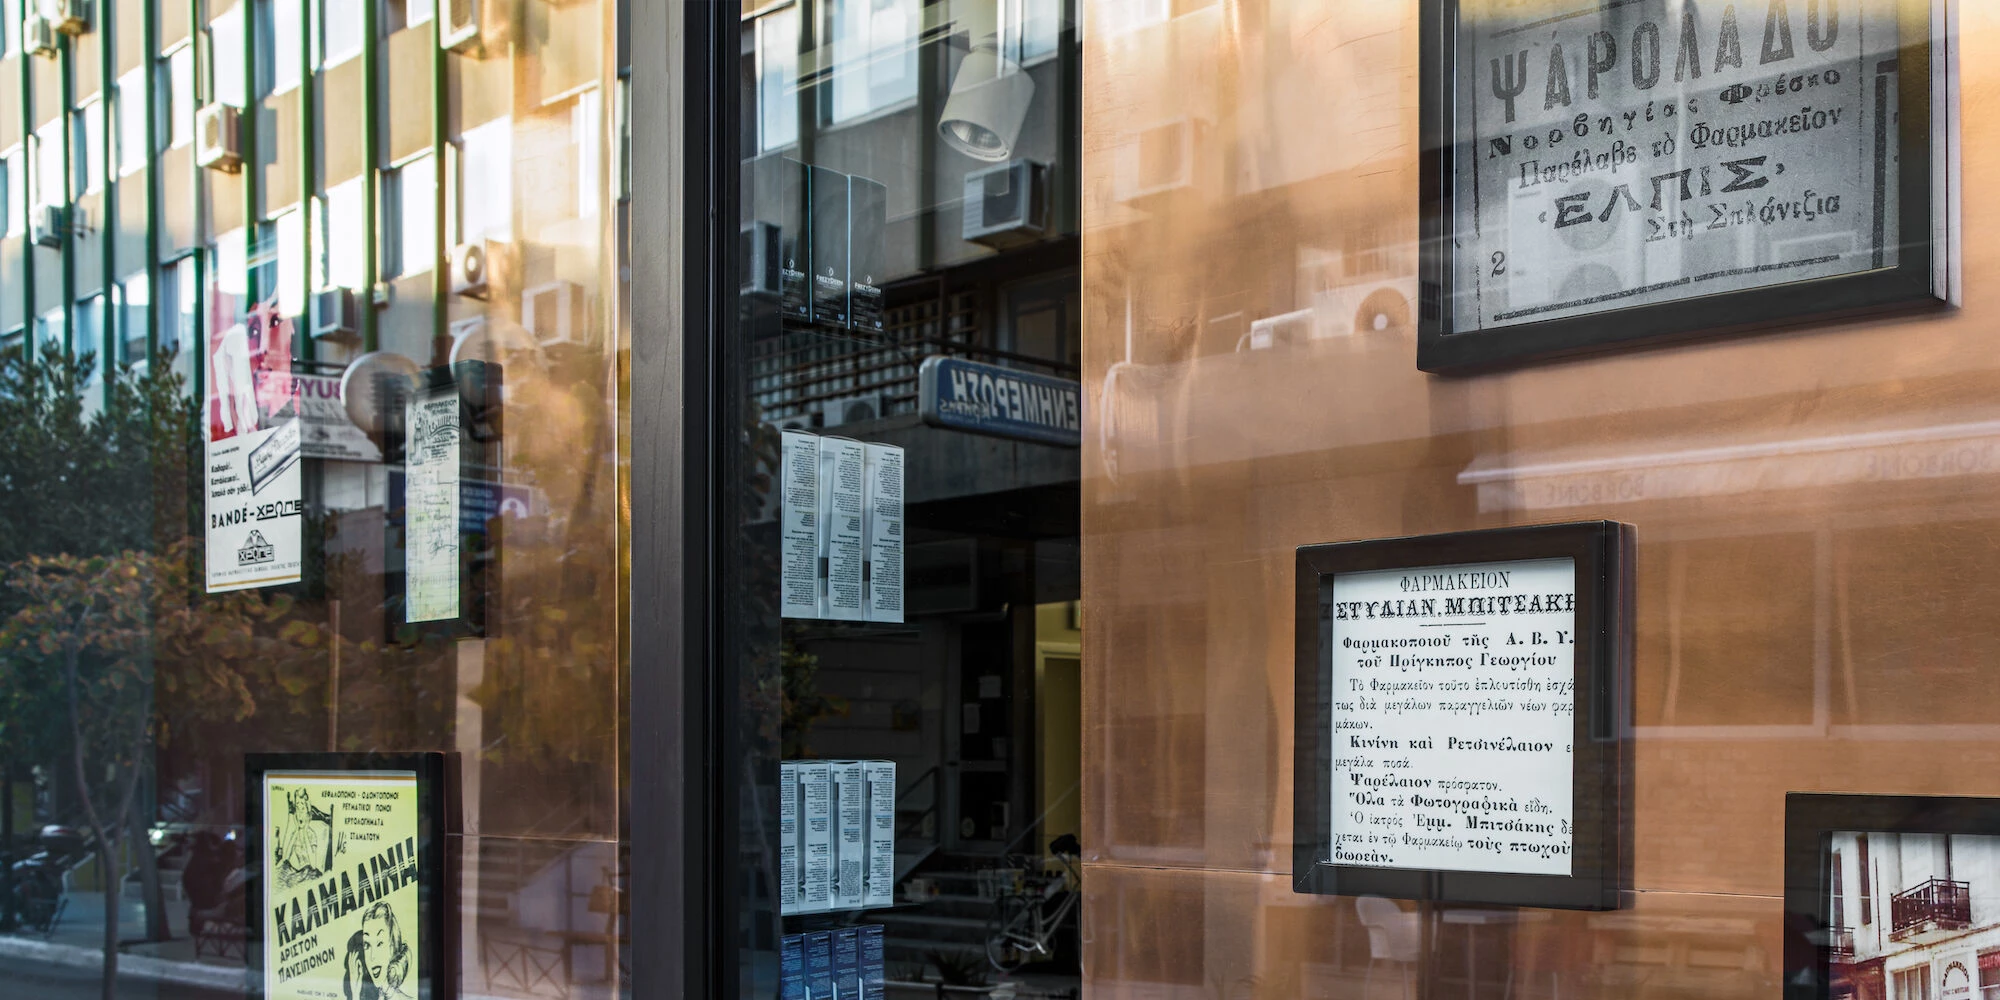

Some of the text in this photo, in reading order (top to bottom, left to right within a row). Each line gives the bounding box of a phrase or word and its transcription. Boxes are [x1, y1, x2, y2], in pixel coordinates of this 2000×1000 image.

[1491, 250, 1506, 278] 2
[1400, 571, 1510, 592] ΦΑΡΜΑΚΕΙΟΝ
[1480, 652, 1557, 672] Γεωργίου
[1335, 702, 1354, 713] τως
[1384, 698, 1432, 716] μεγάλων
[1520, 699, 1547, 712] νέων
[1350, 735, 1399, 750] Κινίνη
[1447, 736, 1554, 753] Ρετσινέλαιον
[1335, 755, 1374, 772] μεγάλα
[1350, 773, 1432, 791] Ψαρέλαιον
[1466, 815, 1554, 837] Μπιτσάκης
[1335, 832, 1363, 846] χεται
[280, 934, 318, 964] ΑΡΙΣΤΟΝ
[278, 946, 336, 985] ΠΑΥΣΙΠΟΝΟΝ
